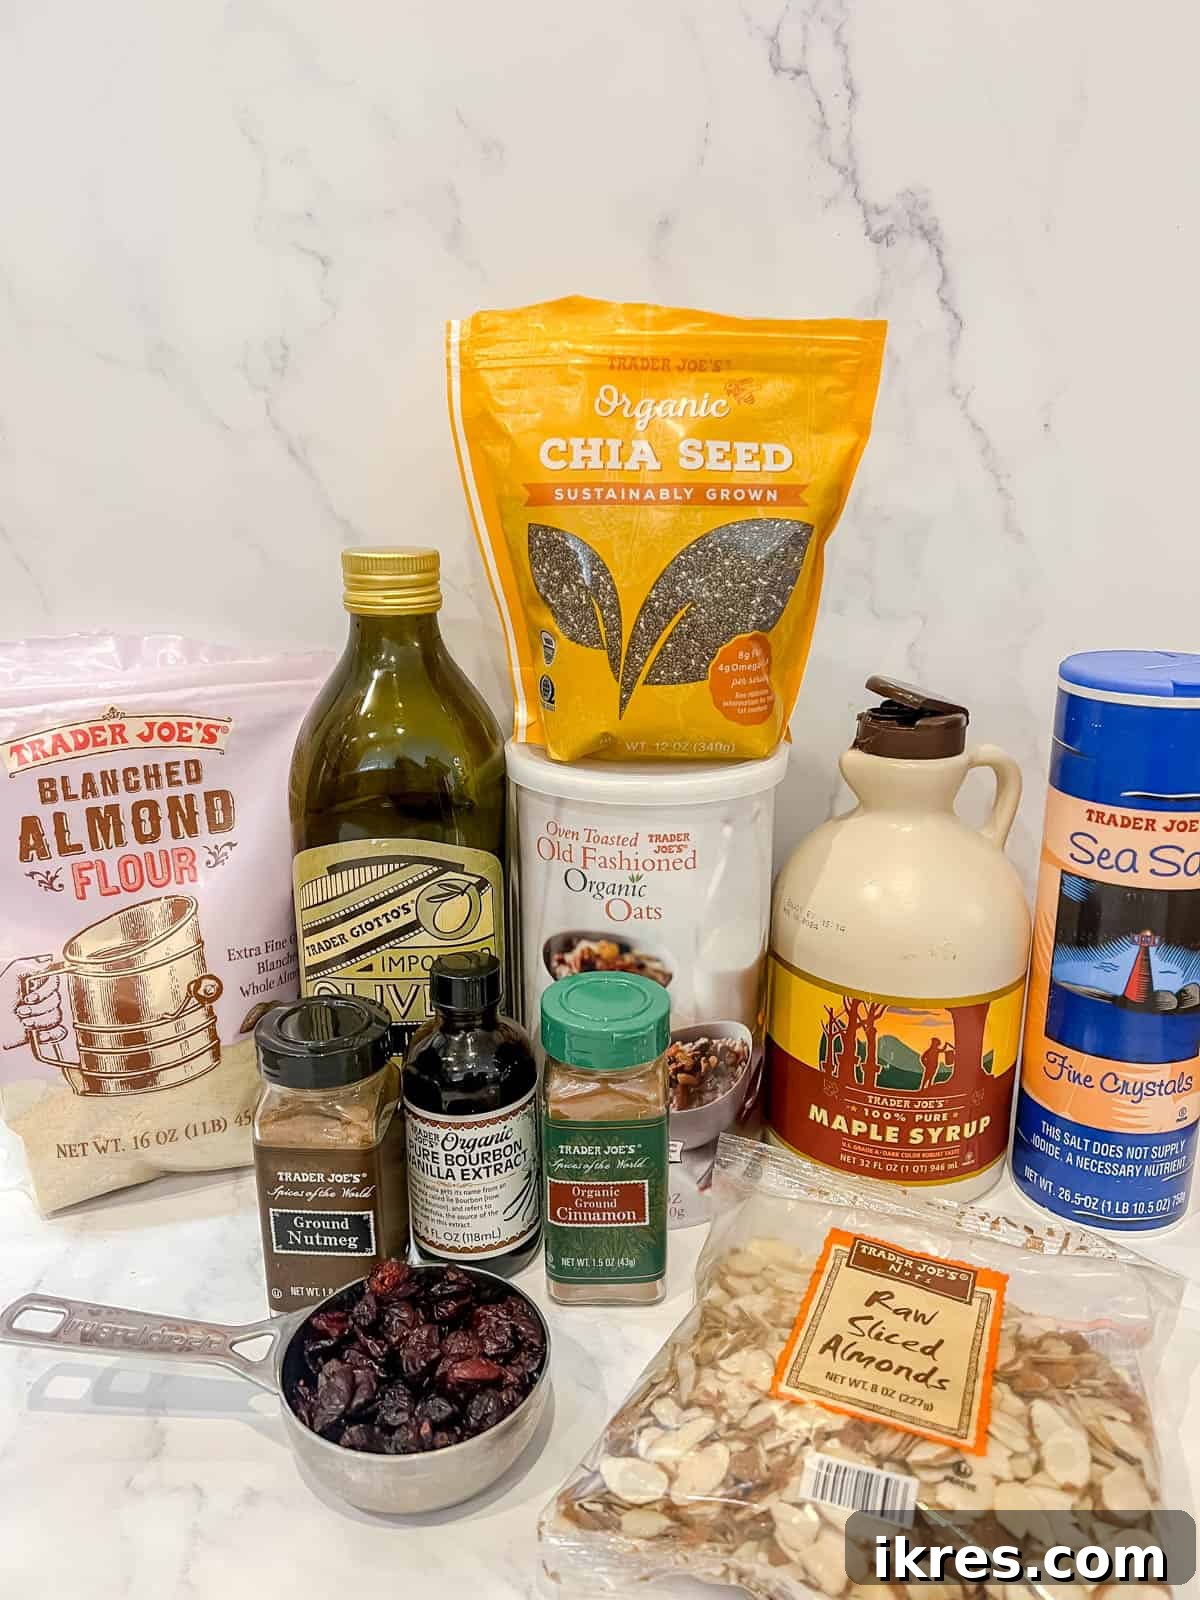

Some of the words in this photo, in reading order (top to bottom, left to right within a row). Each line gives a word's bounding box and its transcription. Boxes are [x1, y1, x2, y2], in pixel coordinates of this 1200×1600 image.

[608, 356, 671, 371] TRADER
[676, 358, 721, 373] JOE'S
[594, 384, 731, 432] Organic
[539, 438, 662, 471] CHIA
[679, 438, 794, 473] SEED
[554, 487, 694, 501] SUSTAINABLY
[706, 488, 778, 502] GROWN
[9, 723, 129, 765] TRADER
[37, 758, 204, 806] BLANCHED
[19, 789, 236, 863] ALMOND
[1086, 808, 1158, 832] TRADER
[1162, 819, 1200, 833] JOE
[546, 820, 580, 841] Oven
[583, 828, 640, 847] Toasted
[648, 832, 690, 843] TRADER
[536, 836, 574, 864] Old
[580, 846, 697, 872] Fashioned
[1069, 831, 1139, 874] Sea
[1149, 845, 1200, 877] Sa
[70, 847, 199, 901] FLOUR
[564, 868, 648, 901] Organic
[605, 898, 663, 922] Oats
[305, 933, 348, 957] TRADER
[350, 902, 412, 939] GIOTTO'S
[227, 945, 262, 962] Extra
[264, 938, 288, 954] Fine
[239, 978, 275, 999] Whole
[1043, 1051, 1095, 1088] Fine
[1099, 1071, 1193, 1104] Crystals
[867, 1095, 910, 1109] TRADER
[913, 1099, 945, 1109] JOE'S
[808, 1103, 900, 1144] MAPLE
[908, 1115, 992, 1145] SYRUP
[863, 1107, 906, 1122] 100%
[915, 1112, 949, 1123] PURE
[56, 1141, 90, 1160] NET
[92, 1138, 126, 1156] WT.
[132, 1130, 151, 1150] 16
[155, 1127, 179, 1146] OZ
[200, 1116, 228, 1138] LB)
[441, 1126, 514, 1154] Organic
[558, 1144, 602, 1155] TRADER
[1041, 1120, 1062, 1141] THIS
[1063, 1130, 1089, 1151] SALT
[1095, 1141, 1123, 1159] DOES
[1126, 1146, 1149, 1160] NOT
[1151, 1139, 1186, 1160] SUPPLY
[408, 1139, 440, 1165] PURE
[444, 1138, 523, 1167] BOURBON
[551, 1158, 584, 1172] Spices
[616, 1156, 651, 1169] World
[839, 1152, 857, 1165] NET
[859, 1158, 870, 1168] 32
[873, 1161, 883, 1170] FL
[885, 1163, 898, 1172] OZ
[1066, 1152, 1073, 1165] A
[1075, 1157, 1141, 1177] NECESSARY
[277, 1171, 325, 1183] TRADER
[407, 1151, 456, 1181] VANILLA
[460, 1150, 529, 1181] EXTRACT
[267, 1185, 304, 1200] Spices
[305, 1187, 319, 1202] of
[319, 1187, 337, 1198] the
[342, 1185, 376, 1199] World
[572, 1186, 621, 1199] Organic
[1024, 1165, 1038, 1185] NET
[1039, 1178, 1057, 1197] WT.
[1115, 1201, 1129, 1214] LB
[1133, 1198, 1154, 1214] 10.5
[556, 1206, 637, 1222] Cinnamon
[574, 1198, 617, 1209] Ground
[293, 1216, 350, 1230] Ground
[443, 1231, 460, 1242] OZ
[462, 1226, 502, 1243] (118mL)
[287, 1230, 360, 1249] Nutmeg
[561, 1257, 575, 1266] NET
[592, 1257, 603, 1267] 1.5
[605, 1257, 616, 1266] OZ
[861, 1244, 914, 1269] TRADER
[888, 1263, 933, 1285] Nuts
[290, 1286, 304, 1297] NET
[864, 1290, 940, 1326] Raw
[847, 1315, 945, 1361] Sliced
[818, 1334, 951, 1391] Almonds
[825, 1371, 847, 1385] NET
[870, 1383, 878, 1394] 8
[880, 1385, 897, 1399] OZ
[898, 1391, 935, 1413] (227g)
